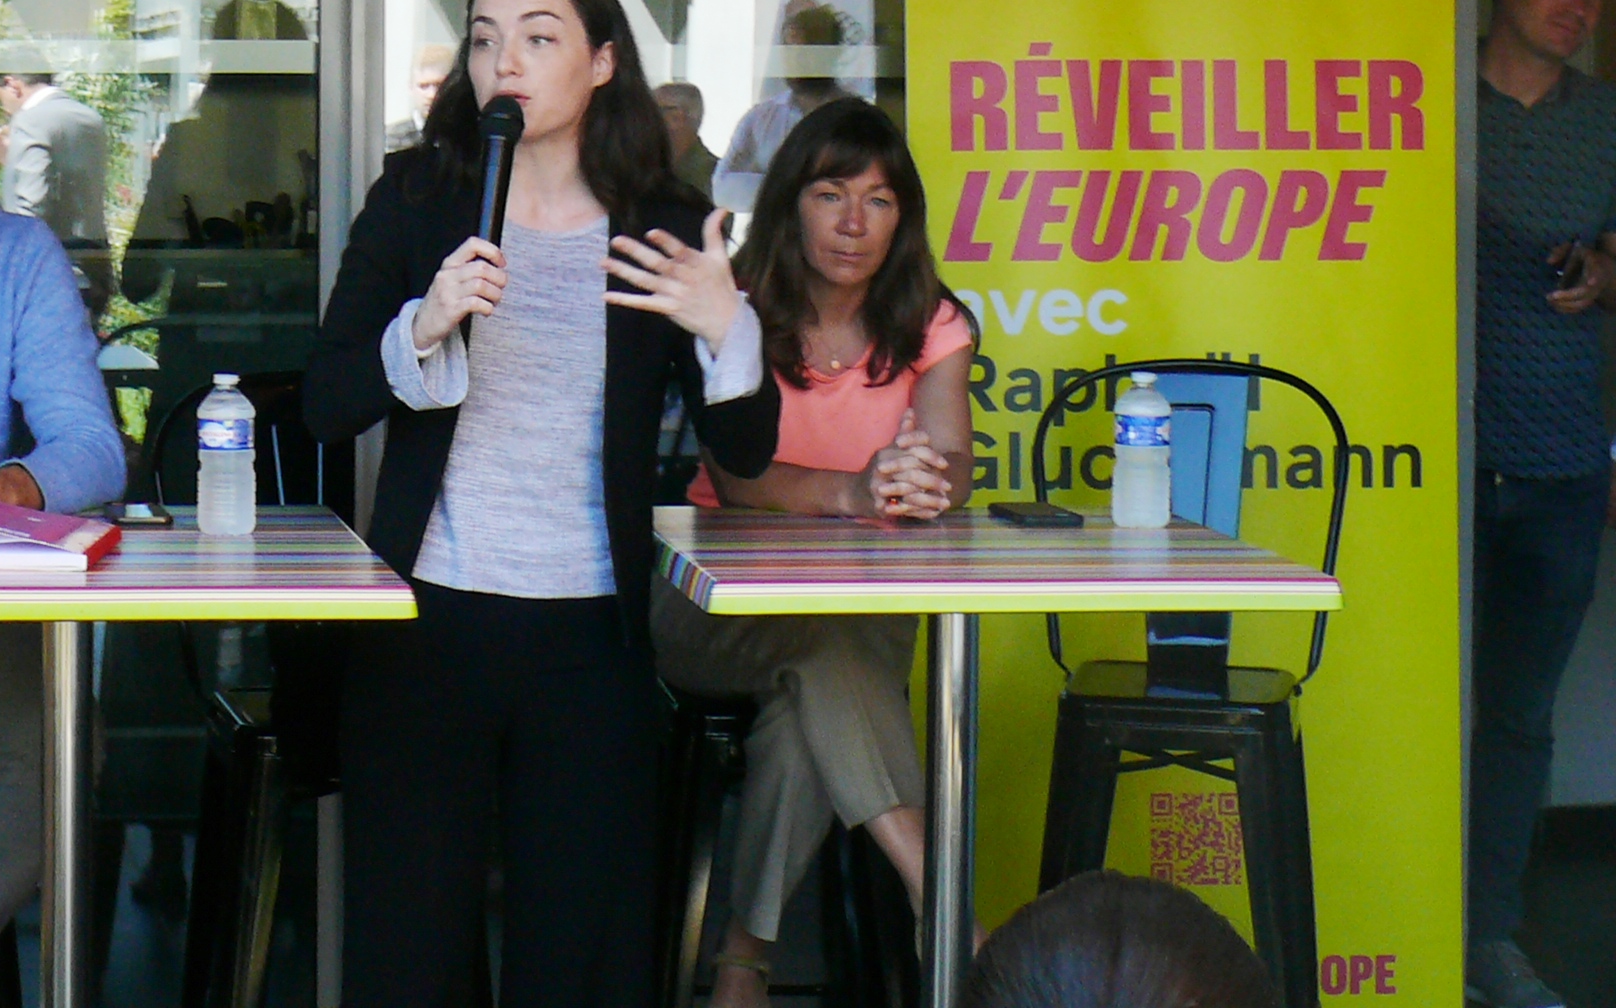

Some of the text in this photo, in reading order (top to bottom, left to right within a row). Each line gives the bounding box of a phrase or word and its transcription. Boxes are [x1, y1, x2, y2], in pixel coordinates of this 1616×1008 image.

[949, 42, 1425, 152] RÉVEILLER
[944, 169, 1387, 263] L'EUROPE
[969, 352, 1260, 427] Raphl
[972, 430, 1422, 490] Glucmann
